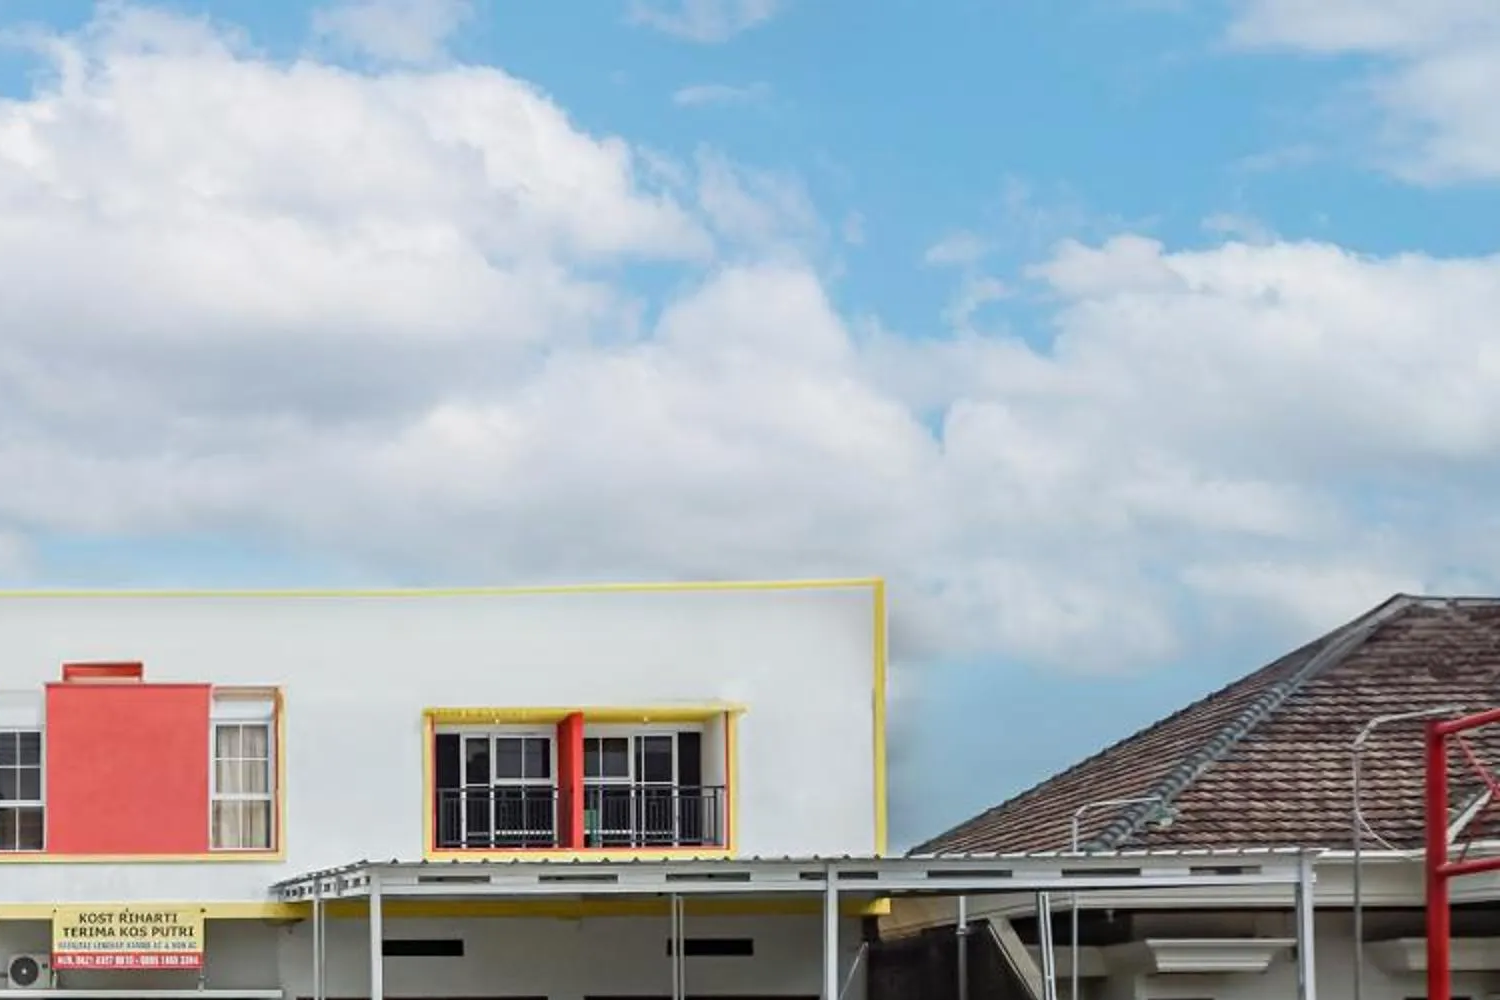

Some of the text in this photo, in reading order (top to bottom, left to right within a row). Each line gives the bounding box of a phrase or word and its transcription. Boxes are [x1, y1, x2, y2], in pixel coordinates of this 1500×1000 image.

[79, 912, 178, 924] KOST RIHARTI
[63, 926, 195, 938] TERIMA KOS PUTRI
